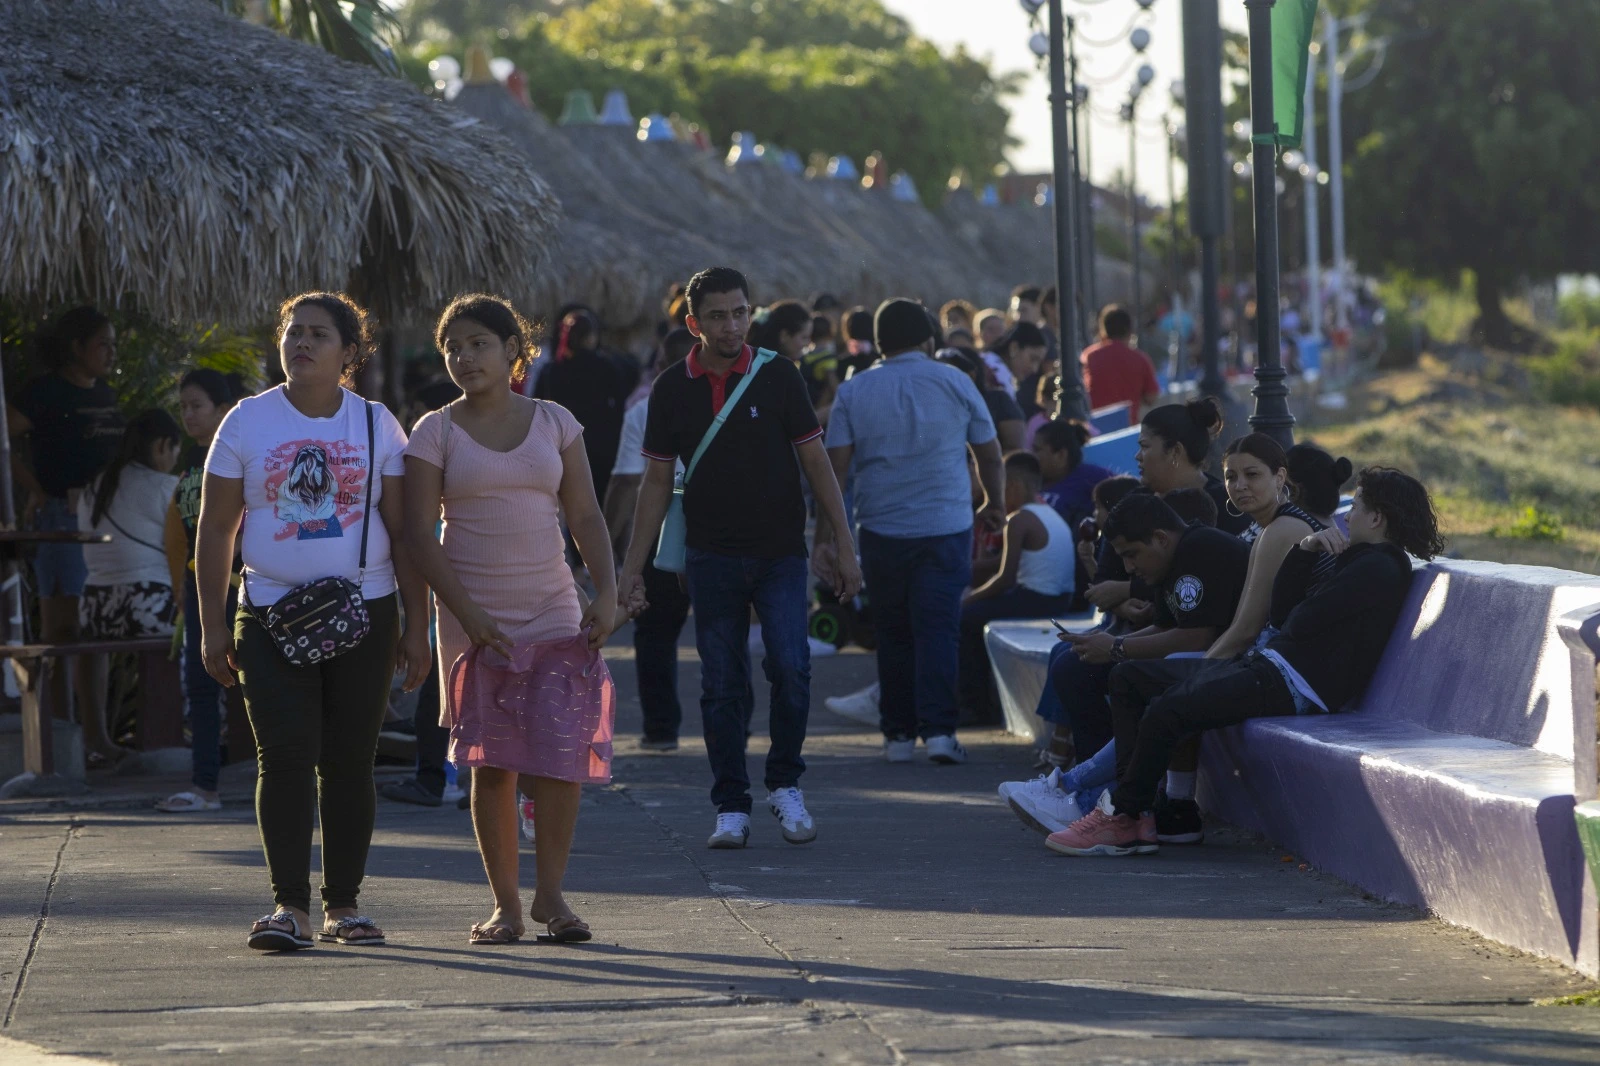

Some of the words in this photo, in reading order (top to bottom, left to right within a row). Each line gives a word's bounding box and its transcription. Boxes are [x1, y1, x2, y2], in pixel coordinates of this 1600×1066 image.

[328, 456, 340, 465] ALL
[341, 456, 350, 466] WE
[351, 457, 366, 468] NEED
[343, 474, 358, 484] is
[337, 491, 359, 505] LOVE
